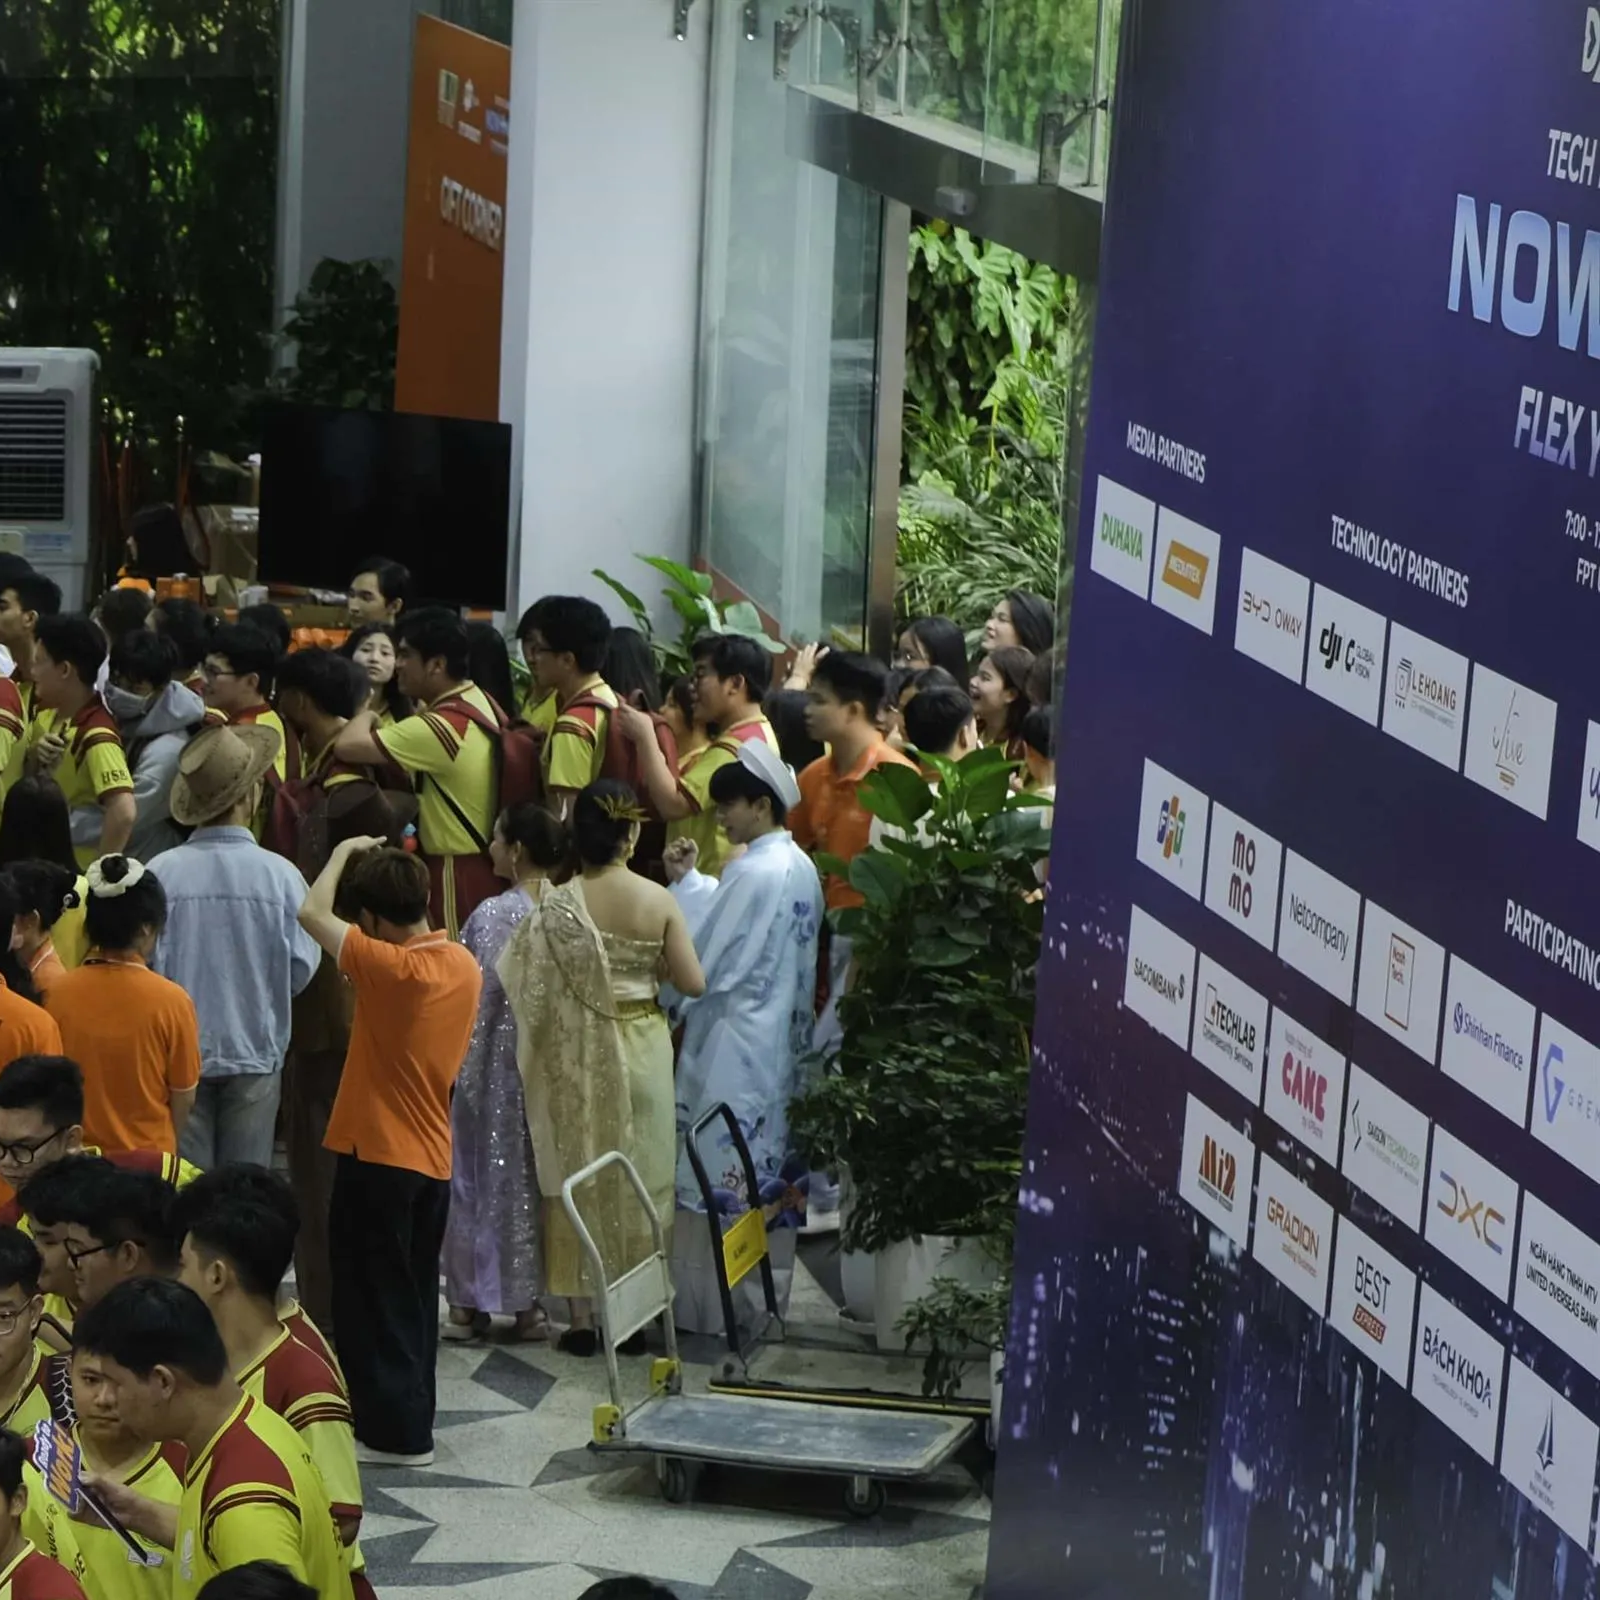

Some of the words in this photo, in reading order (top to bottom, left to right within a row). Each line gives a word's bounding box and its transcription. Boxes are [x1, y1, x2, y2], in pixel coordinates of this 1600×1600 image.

[1547, 129, 1598, 188] TECH
[1126, 421, 1156, 463] MEDIA
[1157, 435, 1207, 484] PARTNERS
[1514, 386, 1577, 471] FLEX
[1101, 513, 1143, 561] DUHAVA
[1565, 508, 1587, 541] 7:00
[1331, 514, 1407, 578] TECHNOLOGY
[1406, 550, 1469, 608] PARTNERS
[1576, 557, 1598, 589] FPT
[1242, 590, 1272, 623] BYD
[1274, 607, 1302, 639] OWAY
[1411, 669, 1457, 712] LEHOANG
[1290, 894, 1349, 961] Netcompany
[1133, 957, 1177, 1005] SACOMBANK
[1215, 1001, 1257, 1052] TECHLAB
[1463, 1013, 1493, 1050] Shinhan
[1493, 1033, 1524, 1071] Finance
[1282, 1050, 1328, 1123] CAKE
[1367, 1121, 1387, 1147] SAIGON
[1267, 1195, 1320, 1261] GRADION
[1354, 1254, 1392, 1314] BEST
[1526, 1261, 1548, 1292] UNITED
[1548, 1281, 1580, 1319] OVERSEAS
[1580, 1304, 1599, 1333] BANK
[1354, 1305, 1386, 1342] EXPRESS
[1423, 1325, 1457, 1378] BÁCH
